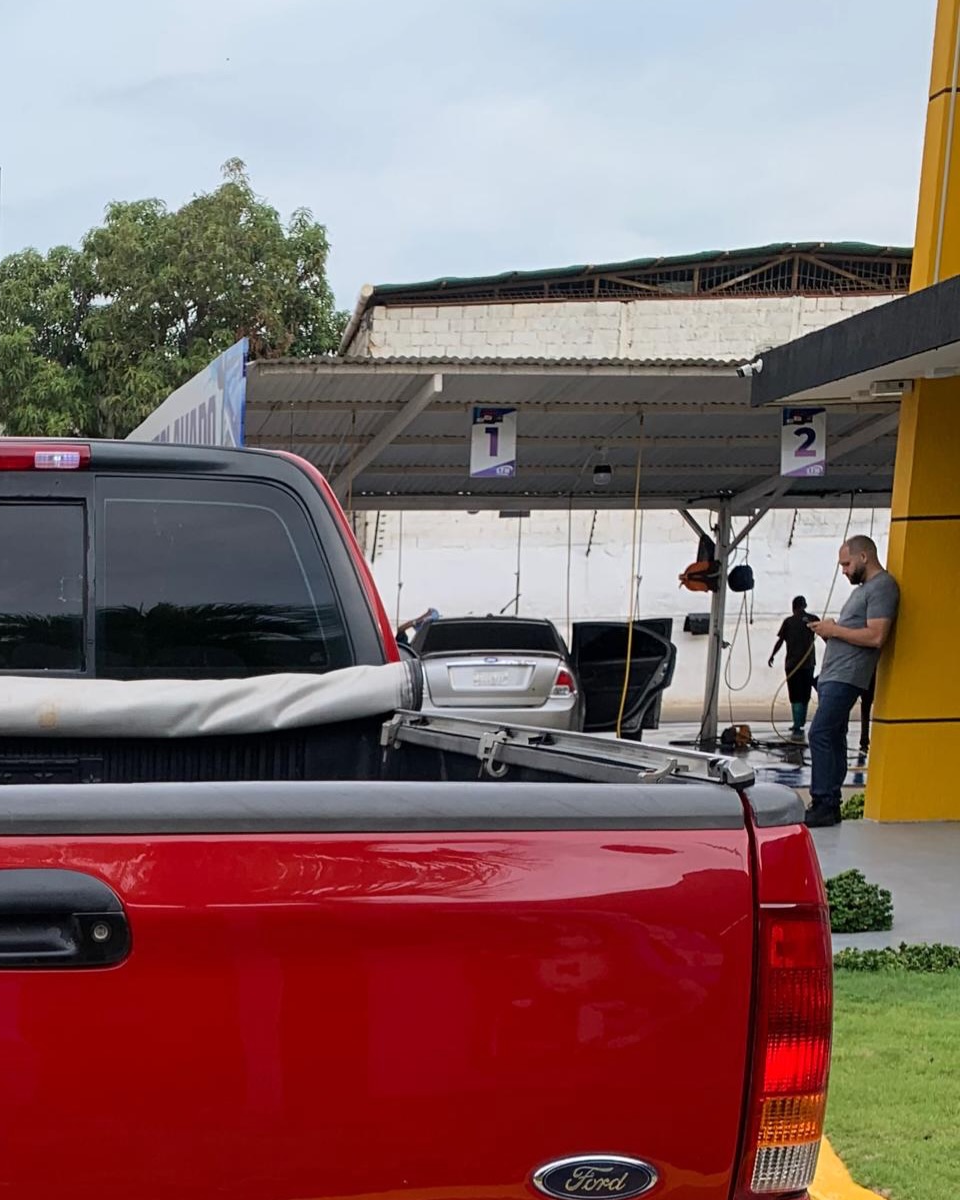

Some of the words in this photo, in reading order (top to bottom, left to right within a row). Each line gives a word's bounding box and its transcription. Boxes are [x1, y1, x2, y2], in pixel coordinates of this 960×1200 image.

[485, 427, 499, 457] 1
[794, 427, 817, 457] 2
[565, 1165, 629, 1191] Ford
